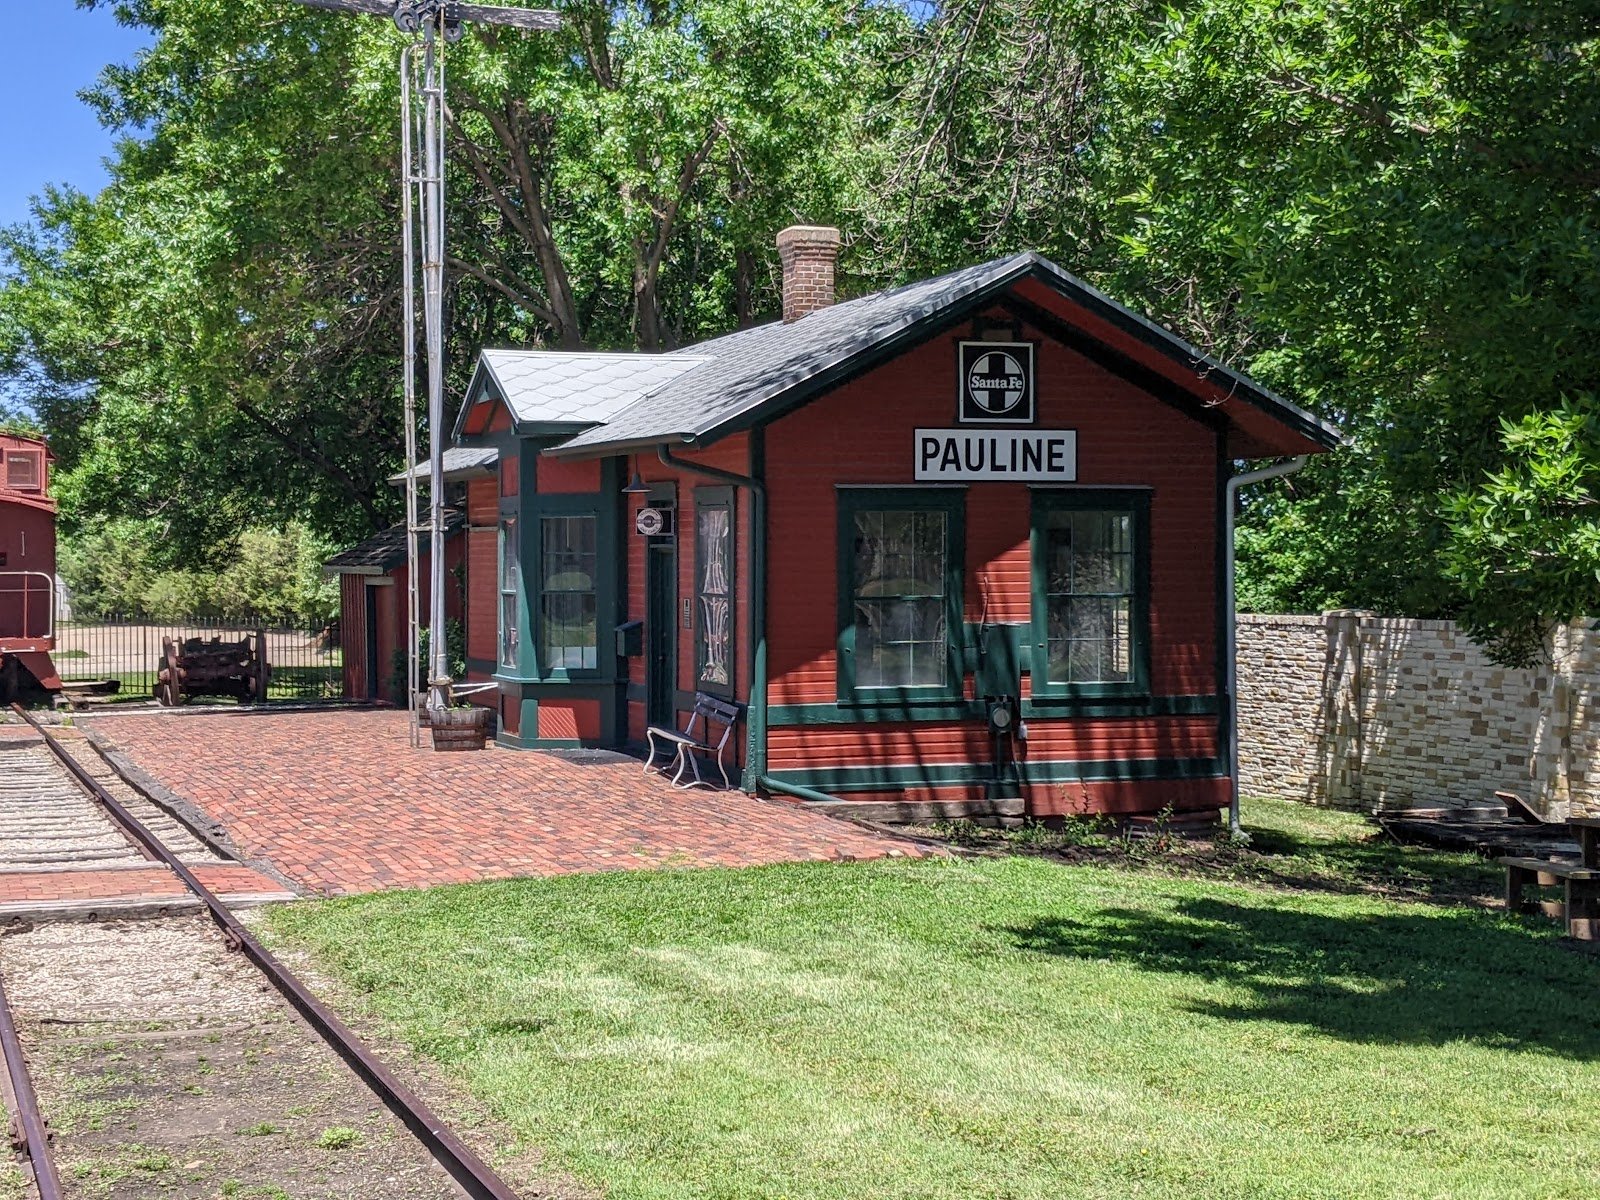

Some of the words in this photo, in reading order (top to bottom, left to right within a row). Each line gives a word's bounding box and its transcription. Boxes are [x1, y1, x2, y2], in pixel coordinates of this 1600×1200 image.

[971, 375, 1008, 389] Santa
[1008, 376, 1023, 390] Fe
[921, 437, 1065, 473] PAULINE
